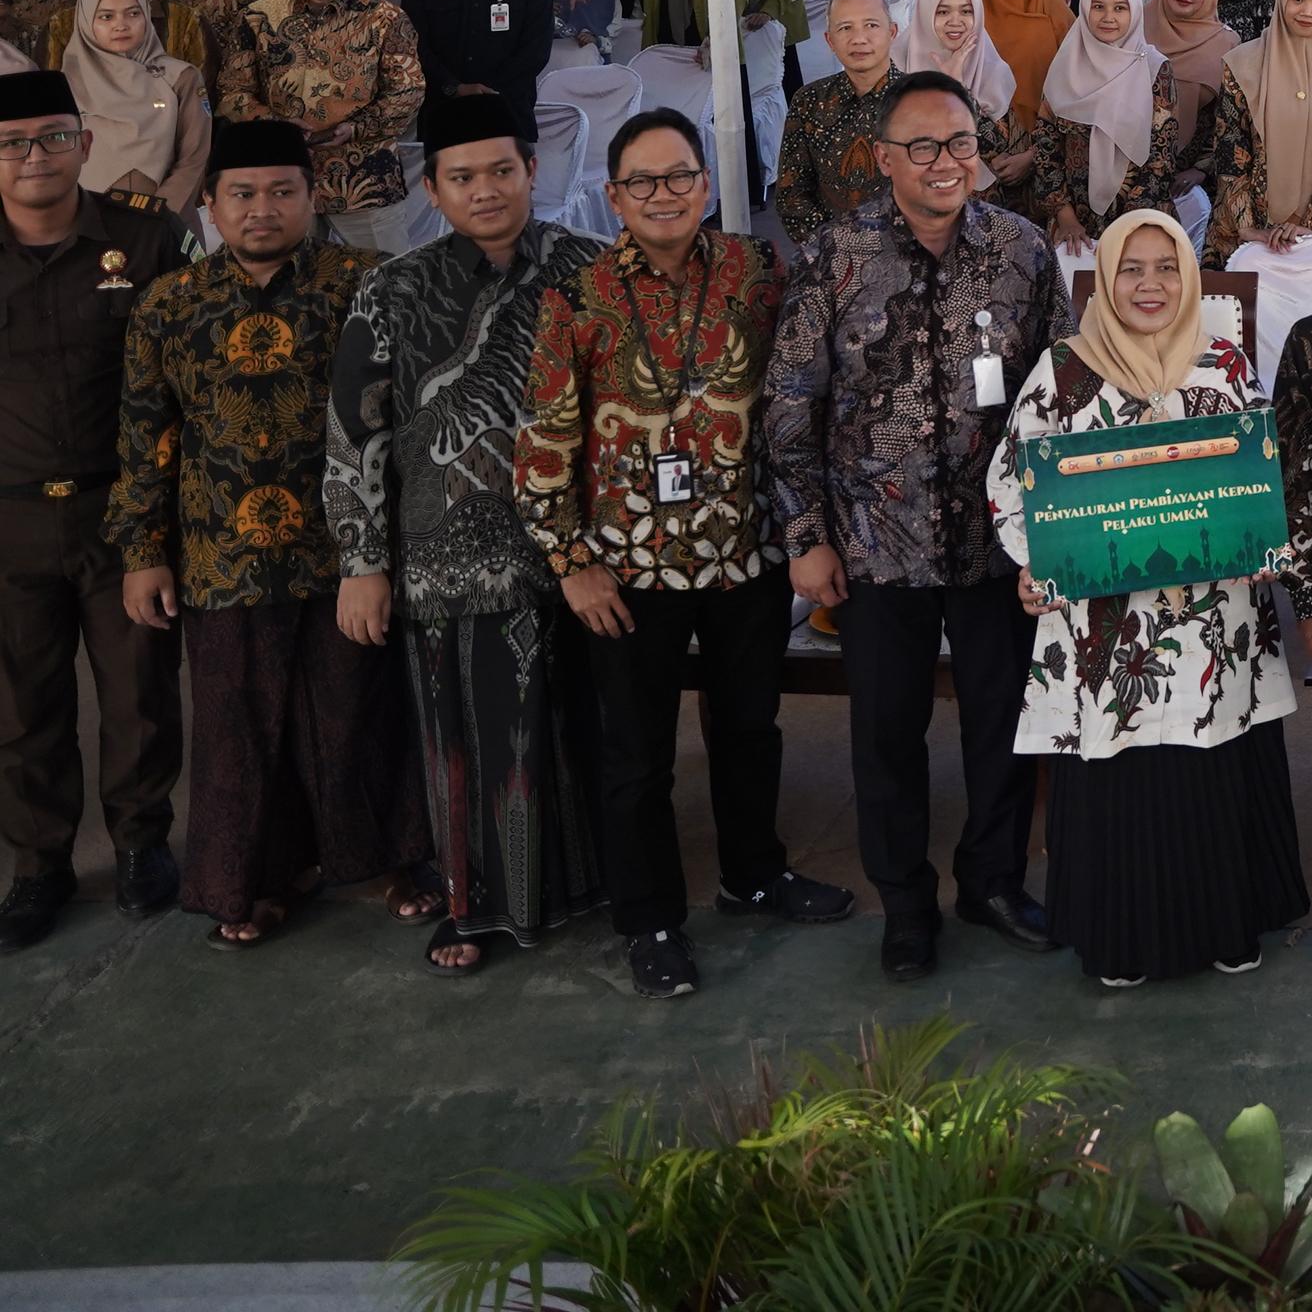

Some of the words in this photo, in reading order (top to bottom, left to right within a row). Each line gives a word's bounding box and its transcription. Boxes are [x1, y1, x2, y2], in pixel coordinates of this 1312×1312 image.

[1034, 501, 1126, 524] PENYALURAN
[1129, 490, 1215, 511] PEMBIAYAAN
[1218, 483, 1272, 499] KEPADA
[1103, 514, 1156, 533] PELAKU
[1159, 504, 1209, 525] UMKM
